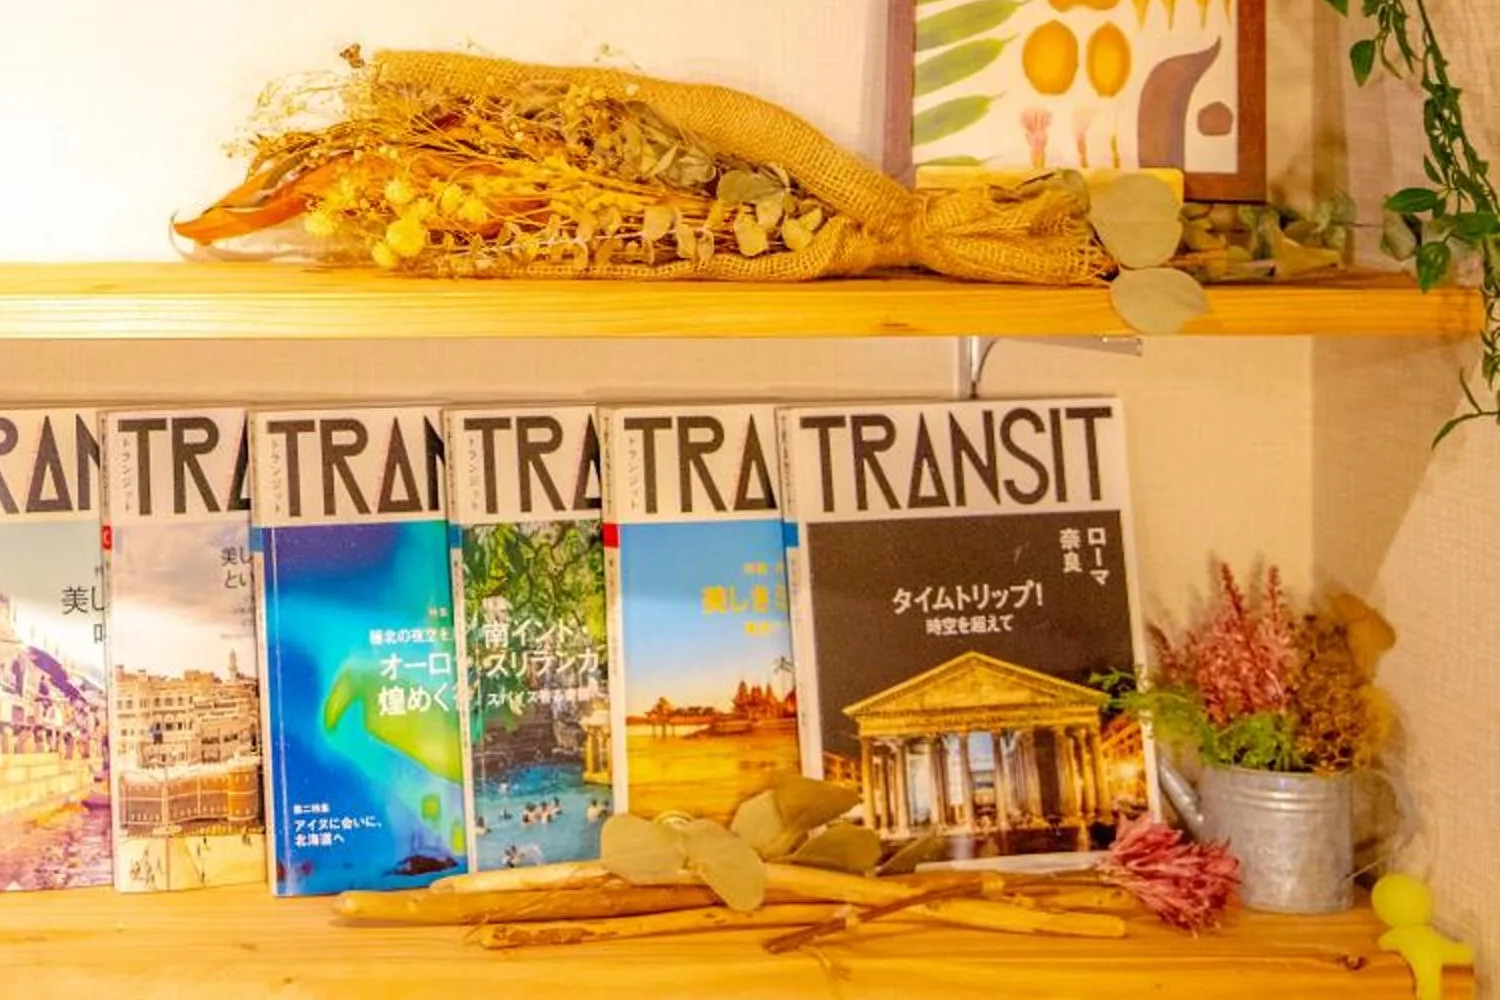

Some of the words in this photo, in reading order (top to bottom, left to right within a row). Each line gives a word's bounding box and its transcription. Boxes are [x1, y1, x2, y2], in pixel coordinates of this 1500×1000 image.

[624, 413, 778, 514] TRA
[801, 405, 1113, 513] TRANSIT
[1059, 528, 1083, 574] 奈良
[1087, 527, 1110, 587] ローマ
[925, 614, 1015, 636] 時空を超えて
[484, 648, 600, 677] スリランカ
[378, 683, 458, 717] 煌めく
